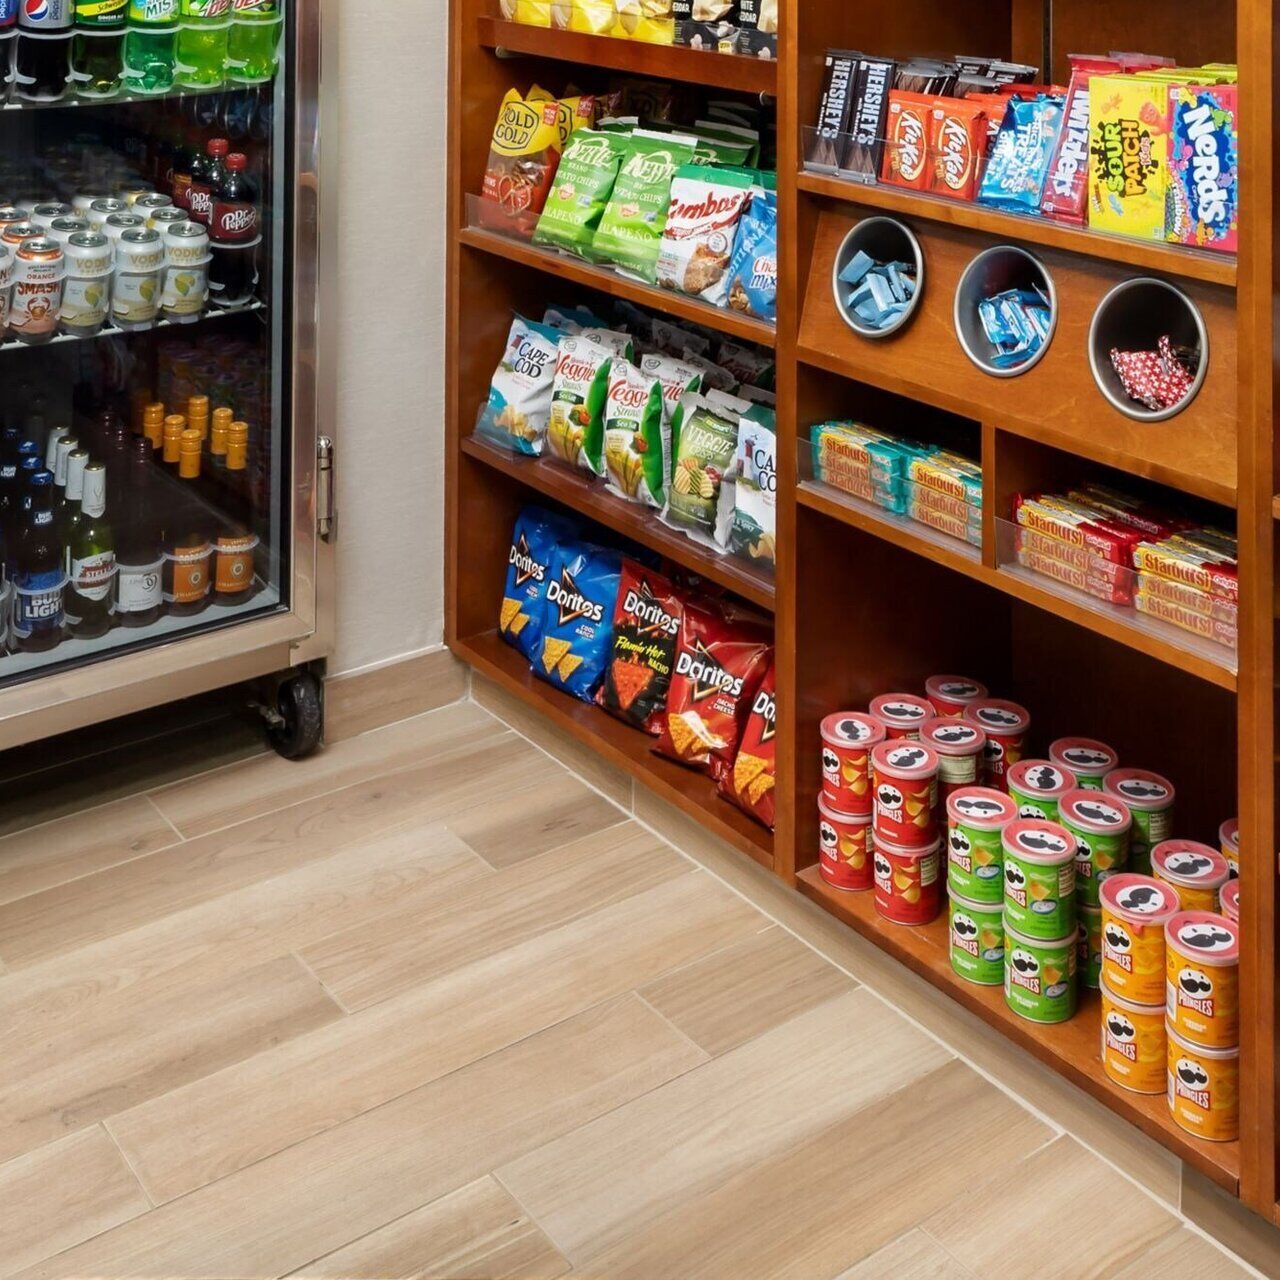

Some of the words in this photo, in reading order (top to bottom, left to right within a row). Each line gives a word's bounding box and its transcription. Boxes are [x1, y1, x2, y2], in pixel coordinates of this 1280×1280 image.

[502, 108, 534, 129] ROLD
[496, 125, 529, 146] GOLD
[1108, 123, 1122, 192] SOUR
[1123, 119, 1140, 198] PATCH
[577, 176, 599, 189] CHIPS
[639, 192, 663, 204] CHIPS
[18, 282, 60, 296] SMASH
[518, 342, 549, 366] CAPE
[514, 356, 542, 380] COD
[688, 426, 734, 456] VEGGIE
[546, 580, 603, 621] Doritos
[624, 591, 680, 635] Doritos
[646, 645, 665, 660] Hot
[648, 659, 669, 675] NACHO
[676, 652, 743, 696] Doritos
[877, 803, 903, 824] PRINGLES
